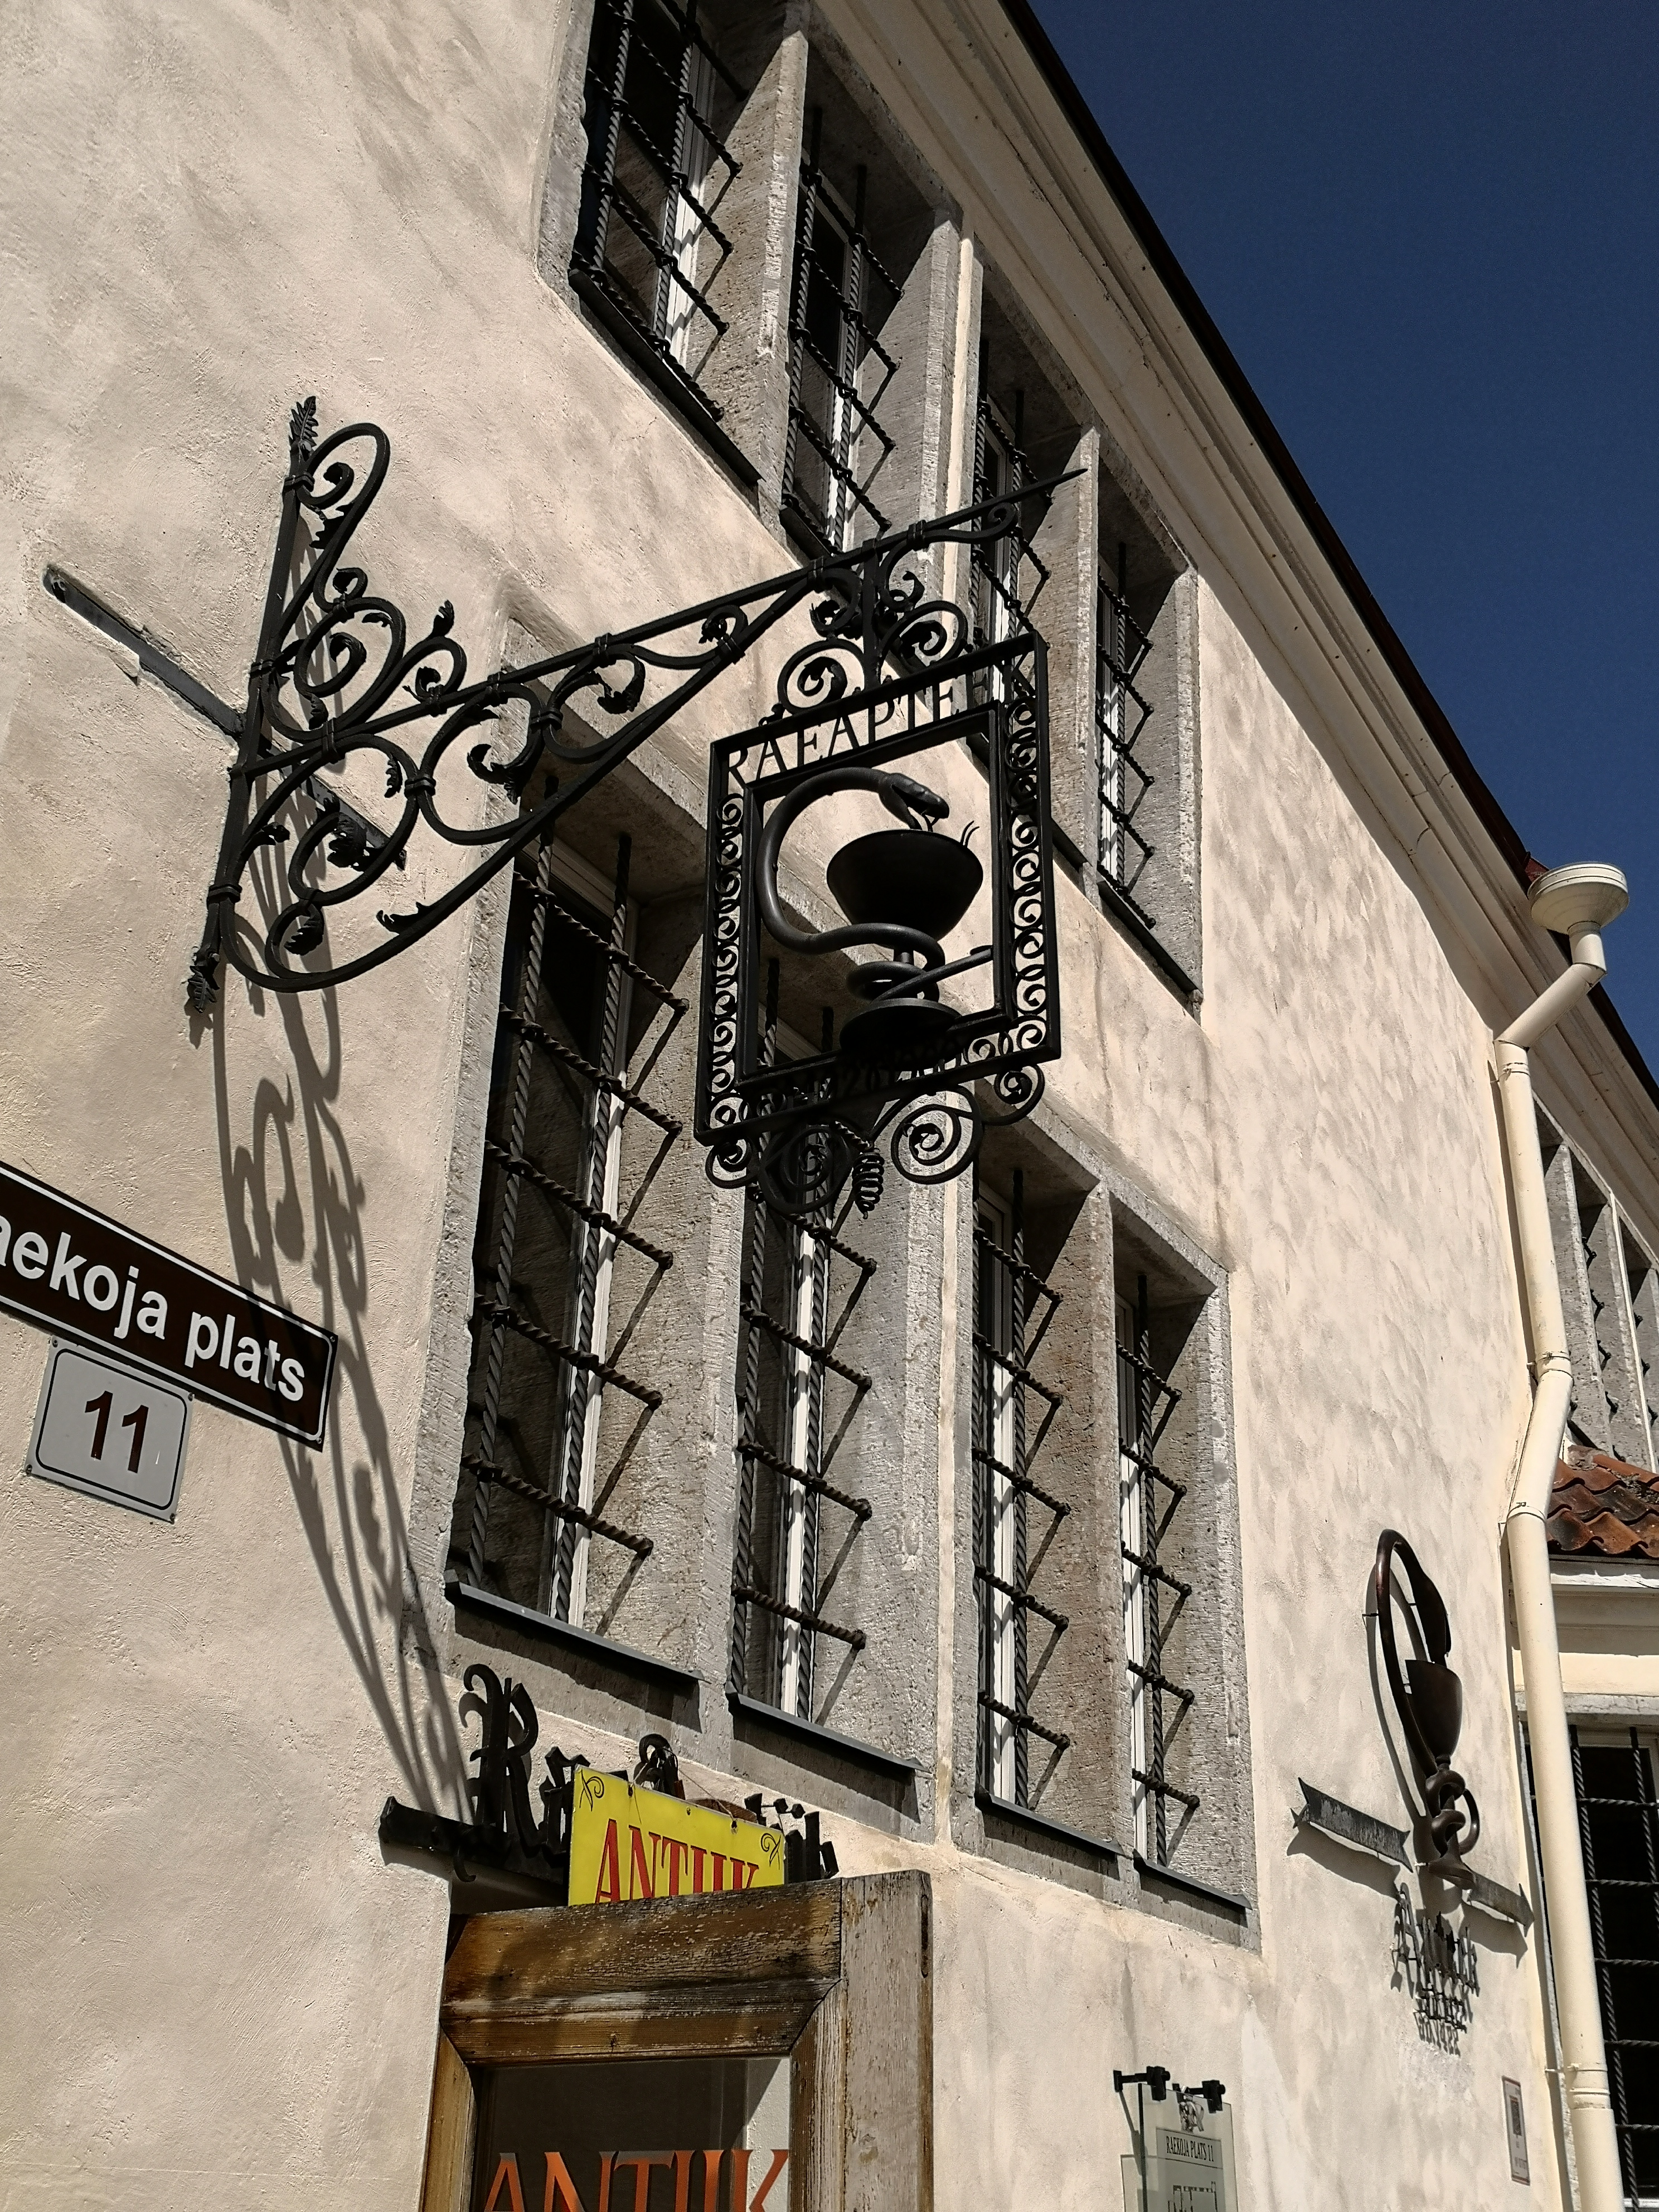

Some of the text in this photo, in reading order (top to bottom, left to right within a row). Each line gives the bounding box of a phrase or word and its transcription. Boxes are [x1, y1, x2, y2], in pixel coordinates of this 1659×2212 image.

[184, 1312, 305, 1401] plats
[84, 1390, 149, 1473] 11
[1166, 2136, 1214, 2162] RAEKOJA PLATS 11
